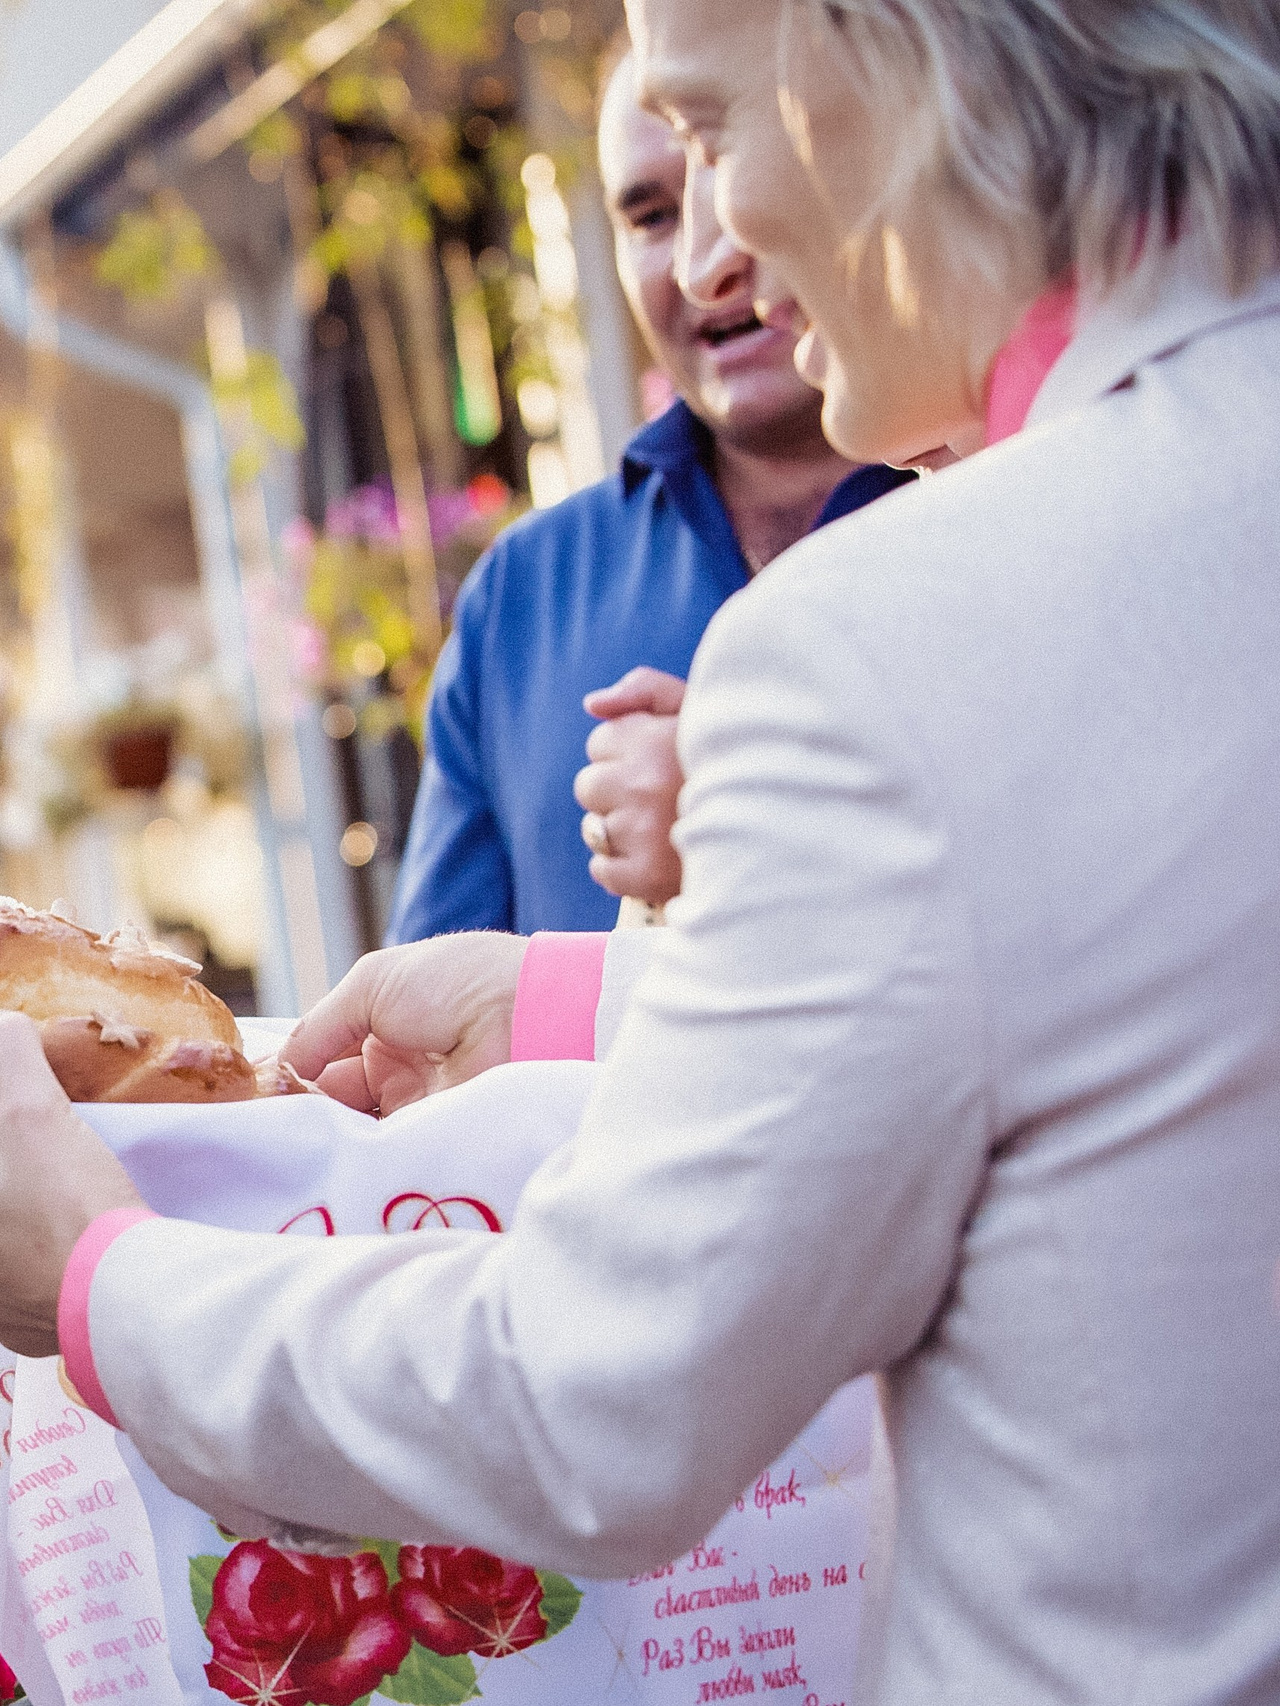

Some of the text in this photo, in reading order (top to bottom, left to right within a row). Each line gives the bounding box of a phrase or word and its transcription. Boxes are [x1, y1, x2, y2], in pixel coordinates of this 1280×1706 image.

[823, 1564, 847, 1588] на
[641, 1638, 684, 1677] Раз
[689, 1626, 731, 1665] Вы
